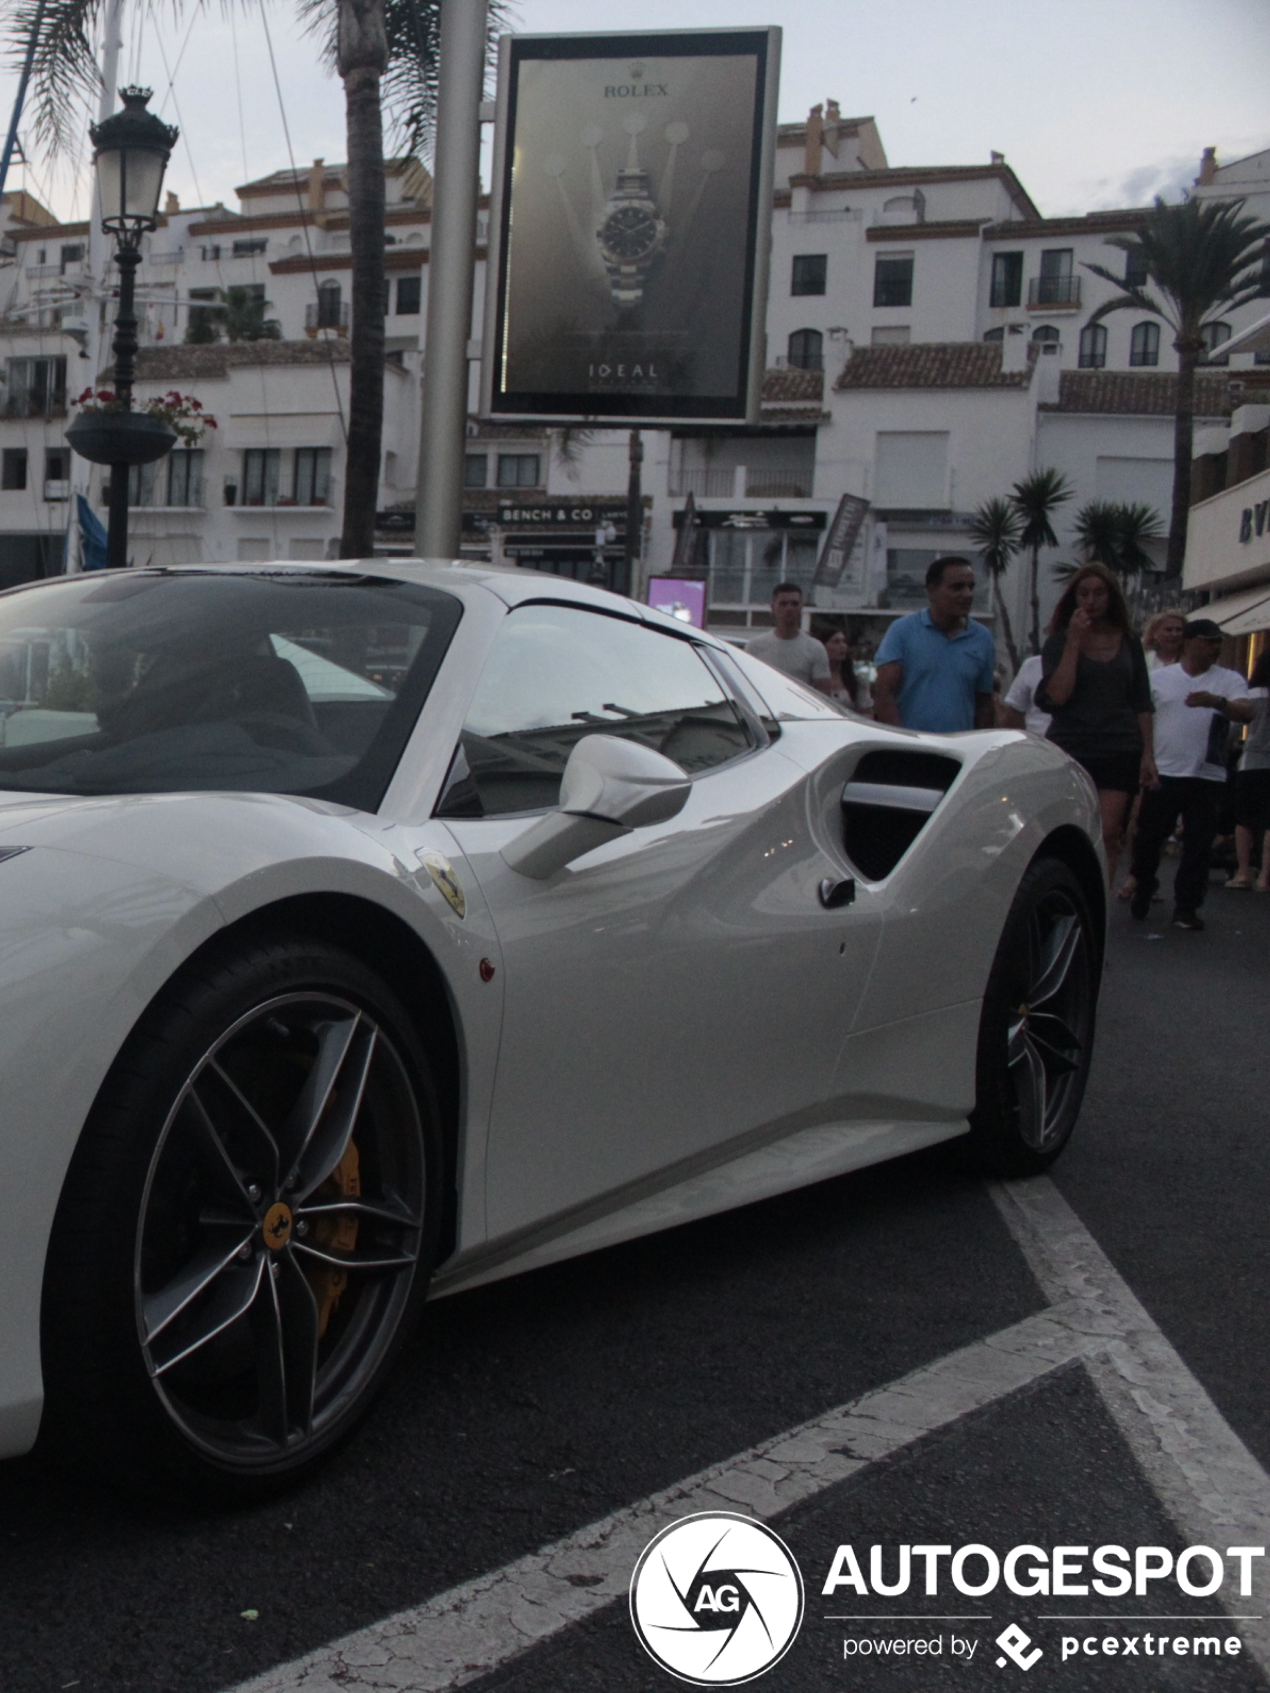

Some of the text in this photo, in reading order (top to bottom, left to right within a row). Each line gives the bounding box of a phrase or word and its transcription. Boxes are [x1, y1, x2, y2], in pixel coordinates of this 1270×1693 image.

[602, 83, 669, 98] ROLEX
[588, 364, 658, 378] IDEAL
[502, 509, 552, 521] BENCH
[557, 509, 566, 521] &
[571, 509, 593, 521] CO
[1238, 498, 1270, 544] BV
